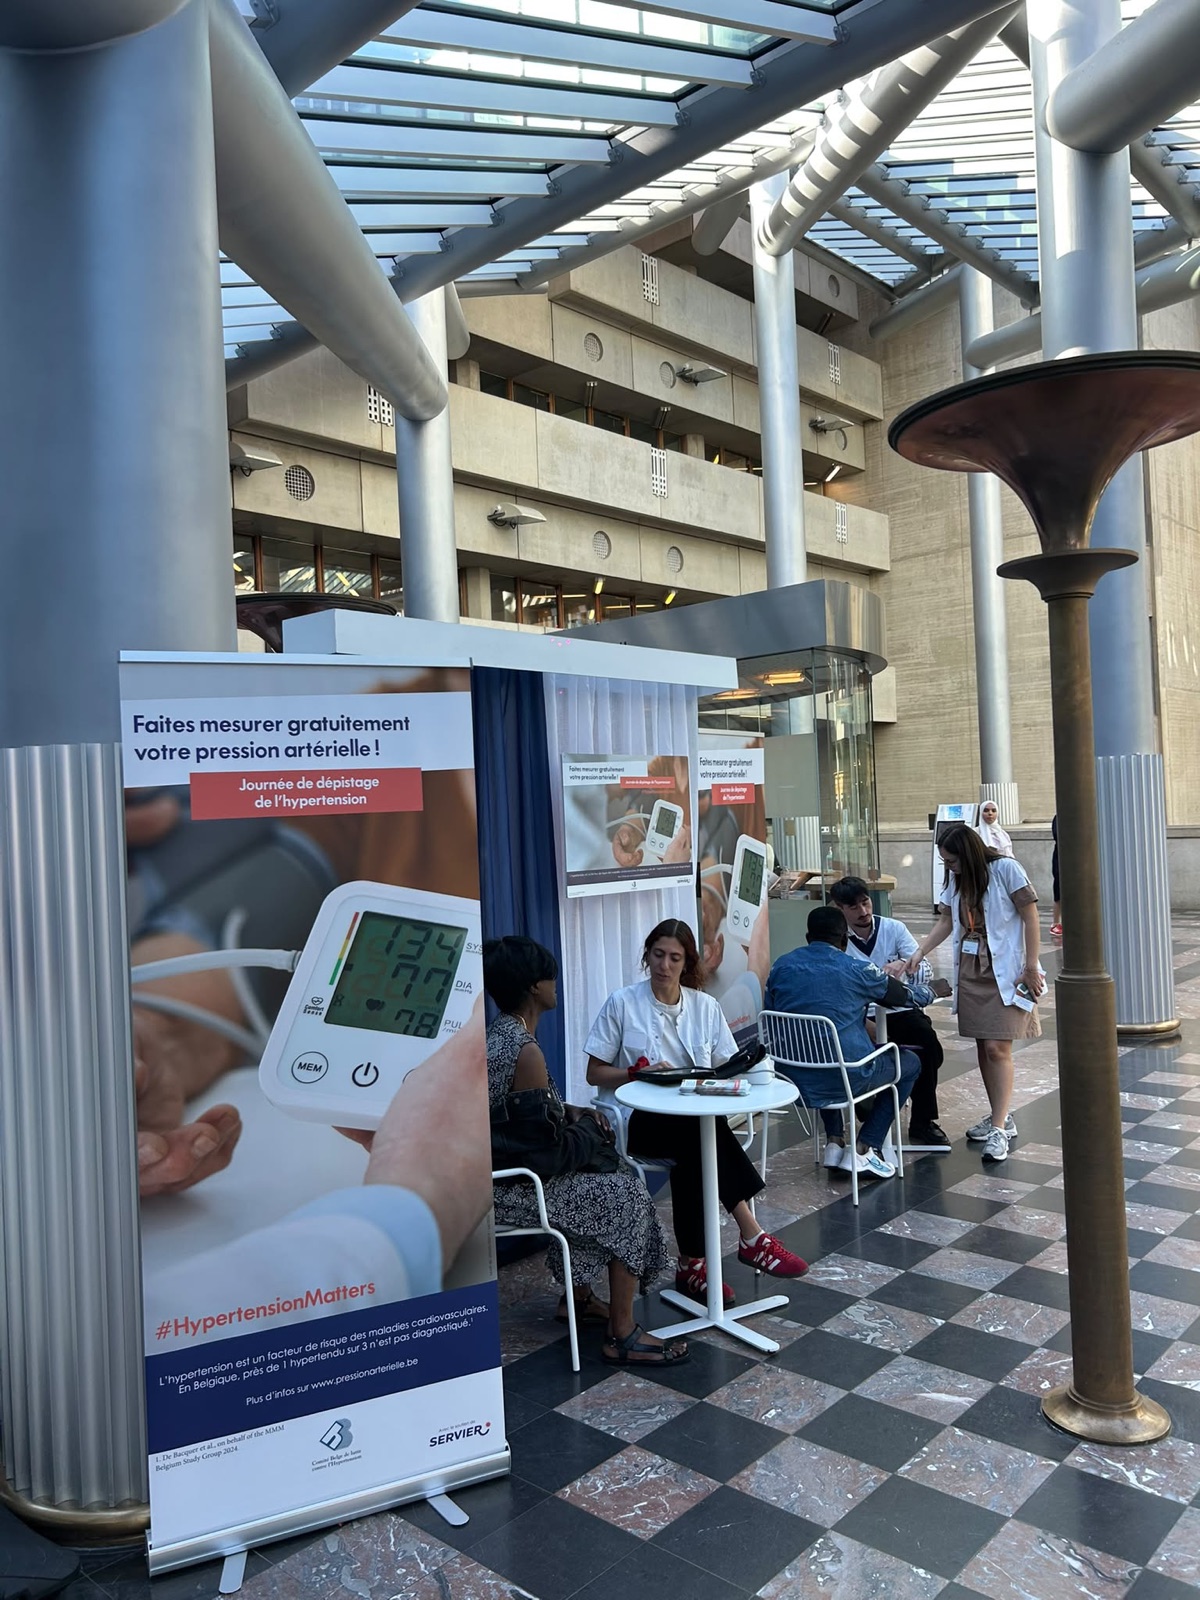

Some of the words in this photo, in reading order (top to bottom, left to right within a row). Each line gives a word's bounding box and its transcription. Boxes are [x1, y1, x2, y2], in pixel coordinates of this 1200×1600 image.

[133, 714, 195, 734] Faites
[199, 717, 283, 734] mesurer
[288, 714, 410, 736] gratuitement
[134, 743, 191, 761] votre
[196, 741, 279, 763] pression
[284, 739, 370, 759] artérielle
[239, 777, 293, 792] Journée
[297, 777, 314, 790] de
[316, 774, 380, 791] dépistage
[255, 795, 272, 809] de
[275, 793, 367, 811] l'hypertension
[385, 924, 463, 965] 134
[391, 962, 452, 1003] 77
[455, 980, 472, 989] DIA
[394, 1009, 439, 1038] 78
[297, 1062, 323, 1073] MEM
[155, 1281, 376, 1341] #HypertensionMatters
[159, 1361, 234, 1386] L'hypertension
[235, 1358, 250, 1368] est
[252, 1355, 265, 1364] un
[267, 1345, 303, 1360] facteur
[305, 1341, 319, 1352] de
[320, 1336, 348, 1350] risque
[350, 1331, 367, 1342] des
[368, 1320, 410, 1337] maladies
[411, 1304, 489, 1328] cardiovasculaires.
[178, 1382, 192, 1394] En
[193, 1371, 241, 1391] Belgique,
[243, 1366, 264, 1380] près
[266, 1361, 280, 1373] de
[290, 1349, 345, 1368] hypertendu
[347, 1345, 360, 1355] sur
[362, 1341, 368, 1351] 3
[369, 1335, 392, 1349] n'est
[394, 1332, 410, 1345] pas
[246, 1396, 264, 1406] Plus
[265, 1388, 296, 1401] d'infos
[297, 1384, 310, 1394] sur
[311, 1357, 419, 1390] www.pressionarterielle.be
[226, 1433, 246, 1445] behalf
[246, 1432, 253, 1440] of
[254, 1430, 264, 1438] the
[265, 1424, 285, 1435] MMM
[429, 1423, 490, 1448] SERVIER
[155, 1460, 182, 1472] Belgium
[183, 1455, 200, 1466] Study
[201, 1450, 222, 1460] Group
